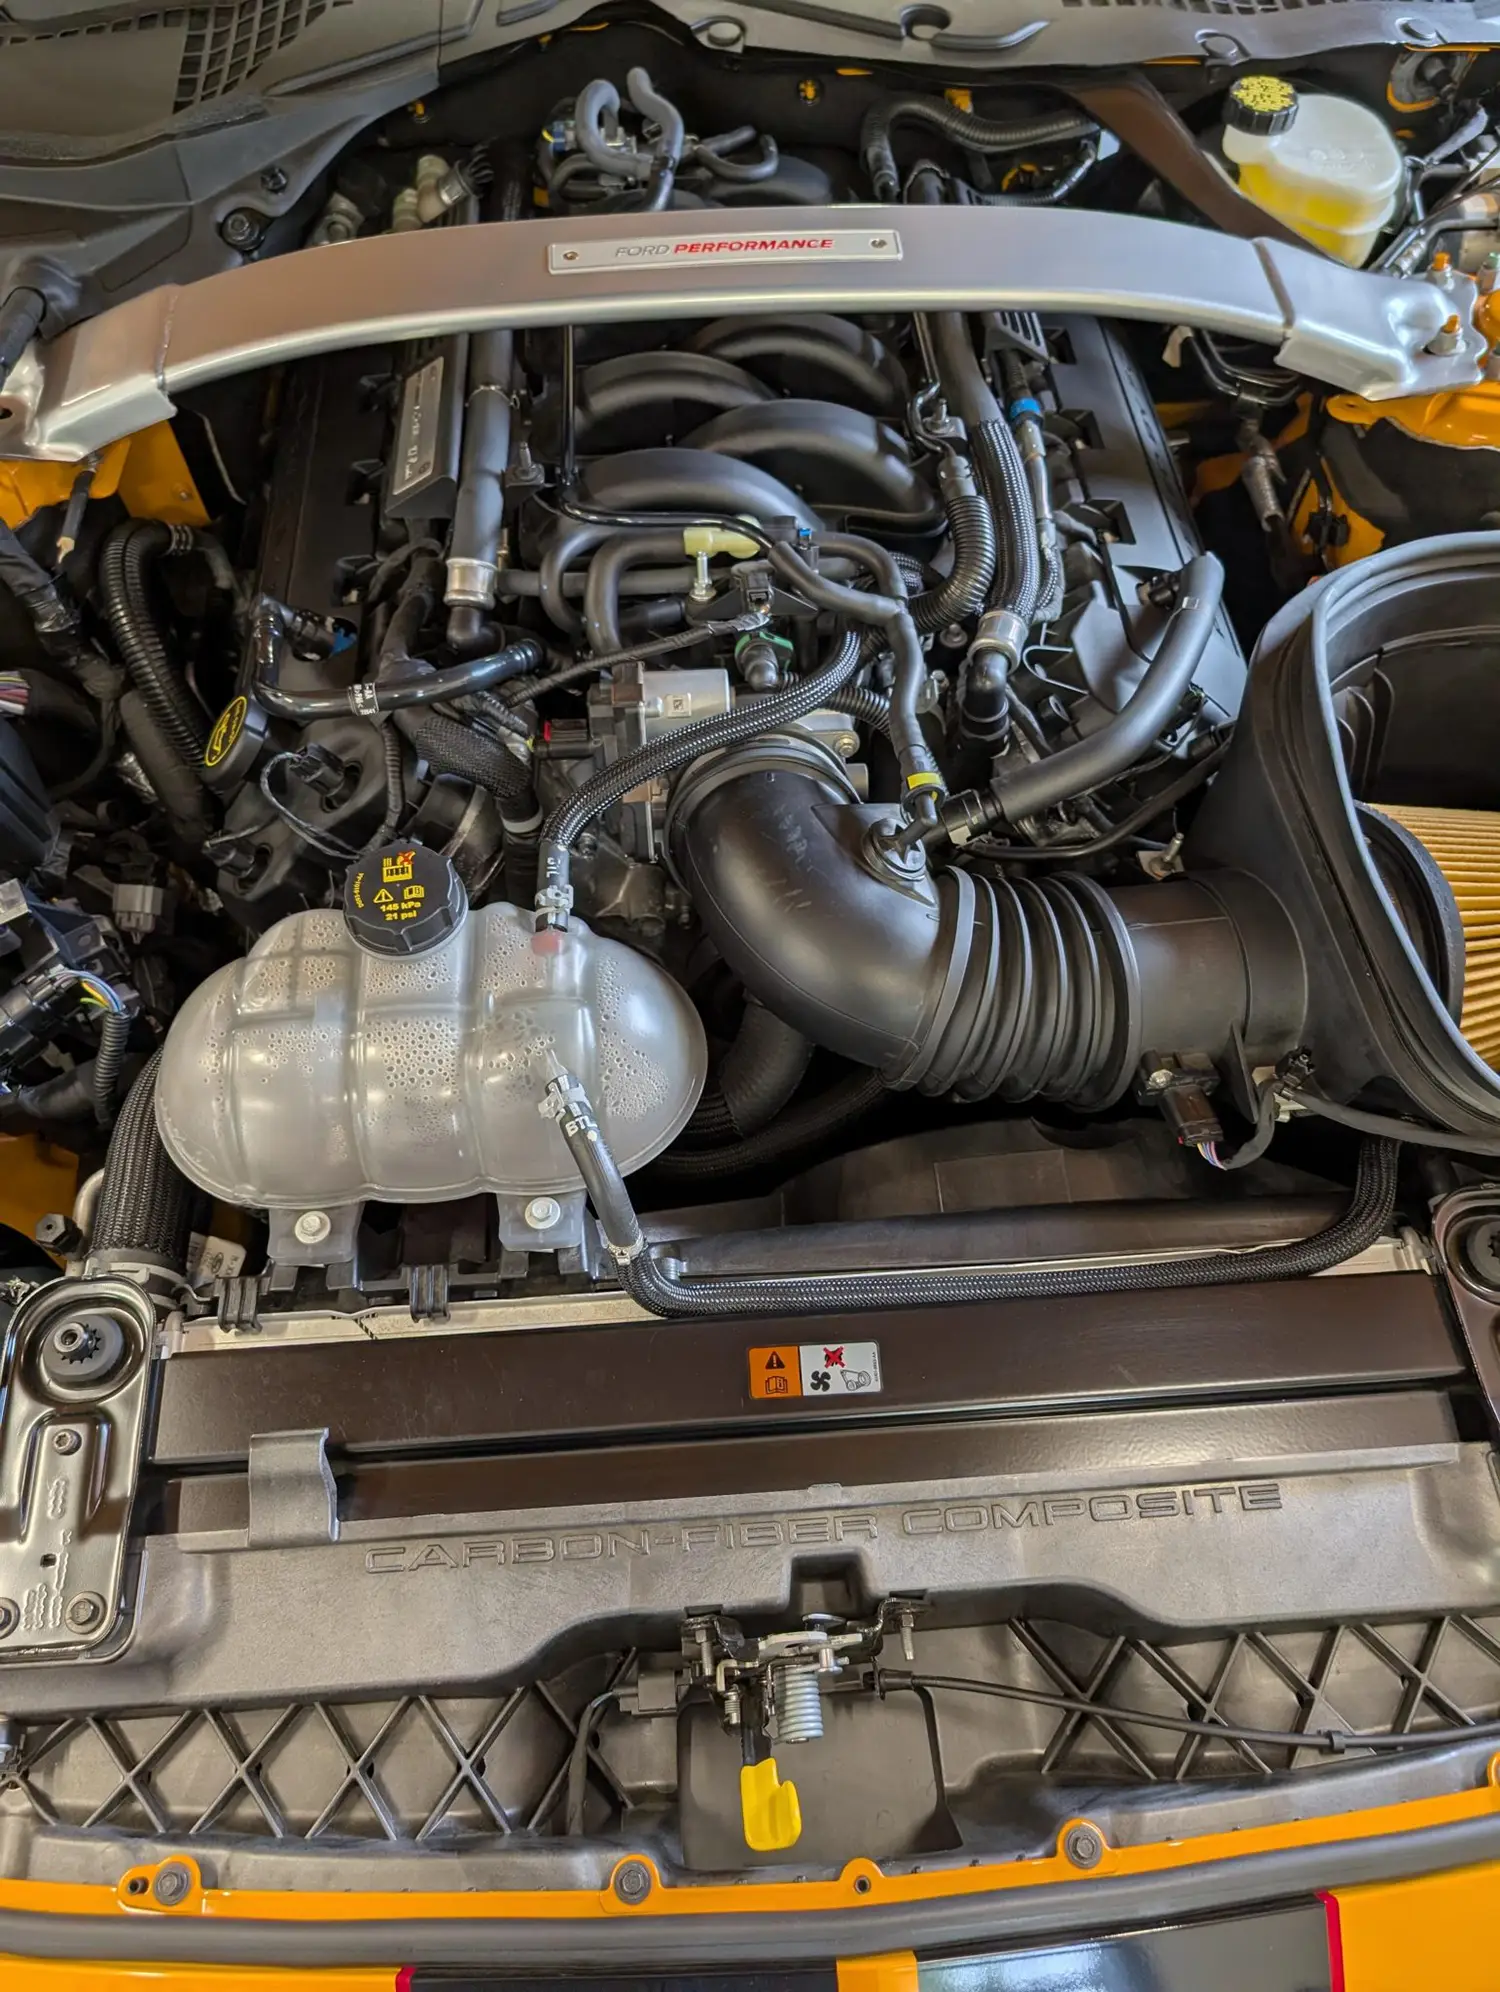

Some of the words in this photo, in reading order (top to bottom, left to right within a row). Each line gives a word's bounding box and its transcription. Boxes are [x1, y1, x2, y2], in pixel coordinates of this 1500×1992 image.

[614, 244, 670, 258] FORD
[673, 239, 835, 254] PERFORMANCE
[380, 903, 399, 912] 145
[401, 901, 421, 910] kPa
[385, 913, 398, 921] 21
[401, 910, 417, 920] psi
[364, 1515, 879, 1574] CARBON-FIBER
[902, 1482, 1284, 1536] COMPOSITE
